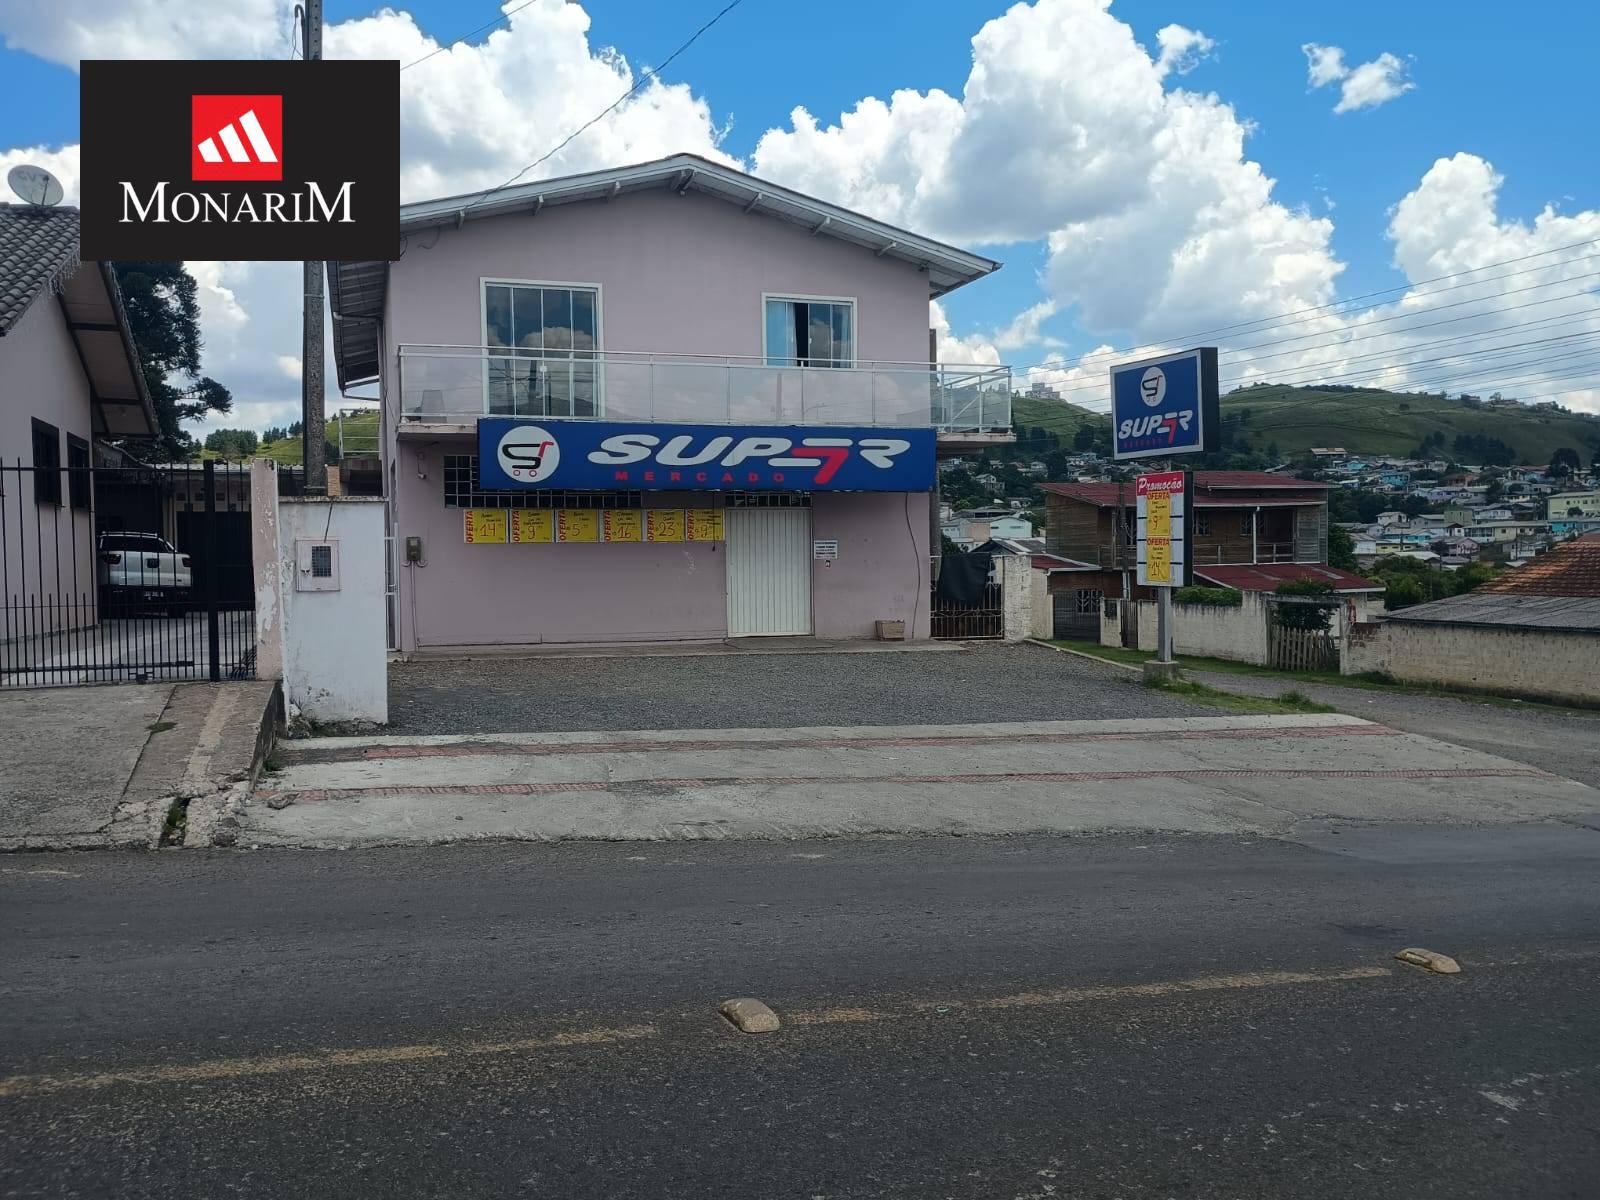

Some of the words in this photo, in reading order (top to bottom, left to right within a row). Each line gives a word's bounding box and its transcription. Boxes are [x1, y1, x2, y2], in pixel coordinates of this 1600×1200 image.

[614, 471, 786, 483] MERCADO
[1147, 491, 1170, 500] OFERTA
[465, 510, 474, 543] OFERTA
[479, 522, 496, 537] 14
[512, 510, 521, 543] OFERTA
[558, 510, 567, 541] OFERTA
[604, 510, 612, 542] OFERTA
[647, 510, 655, 541] OFERTA
[659, 521, 675, 537] 23
[687, 509, 695, 540] OFERTA
[1147, 538, 1170, 546] OFERTA
